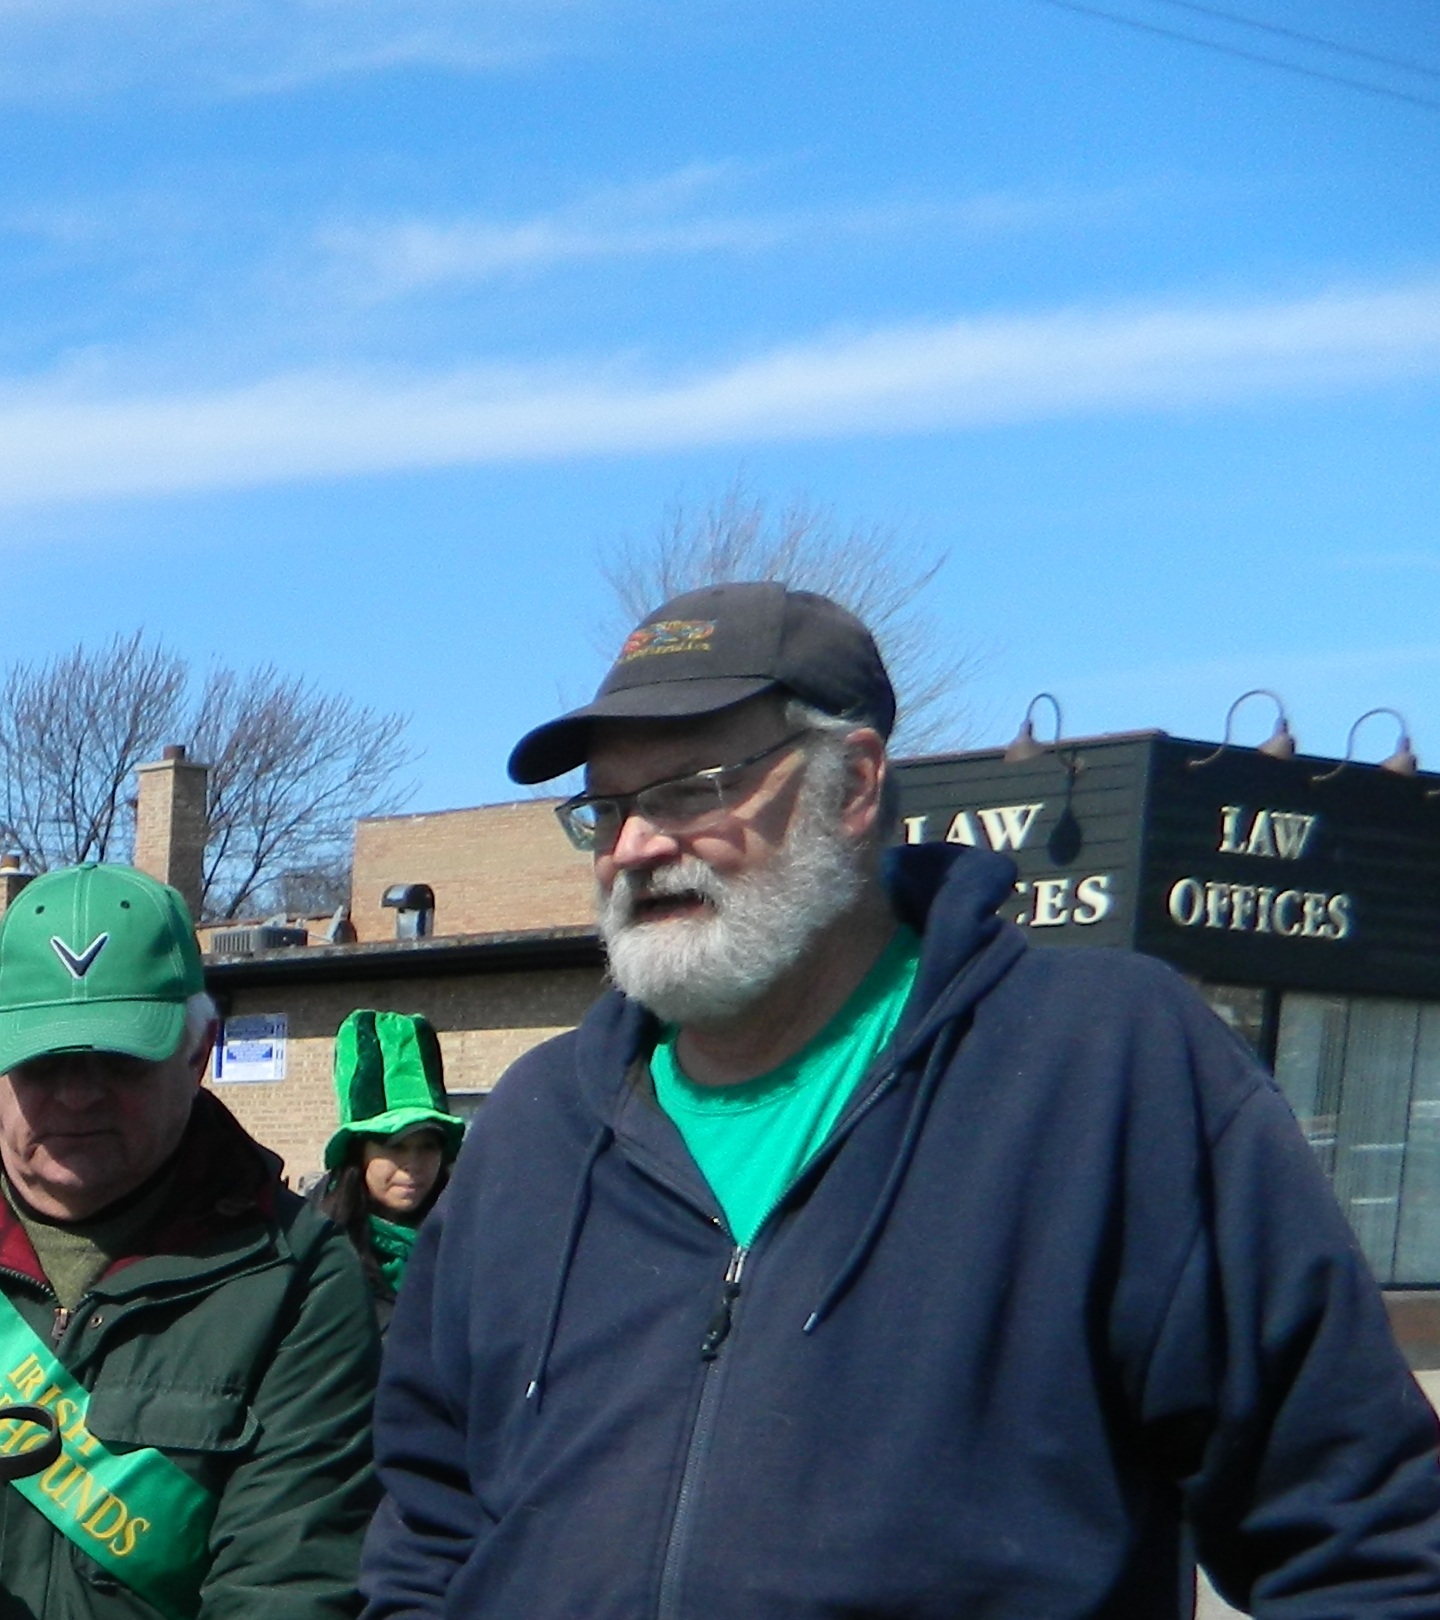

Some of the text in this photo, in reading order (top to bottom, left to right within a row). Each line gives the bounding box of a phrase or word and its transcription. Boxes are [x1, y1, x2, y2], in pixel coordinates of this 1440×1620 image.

[1219, 805, 1317, 861] LAW
[1169, 878, 1352, 940] OFFICES
[7, 1353, 102, 1457] IRISH
